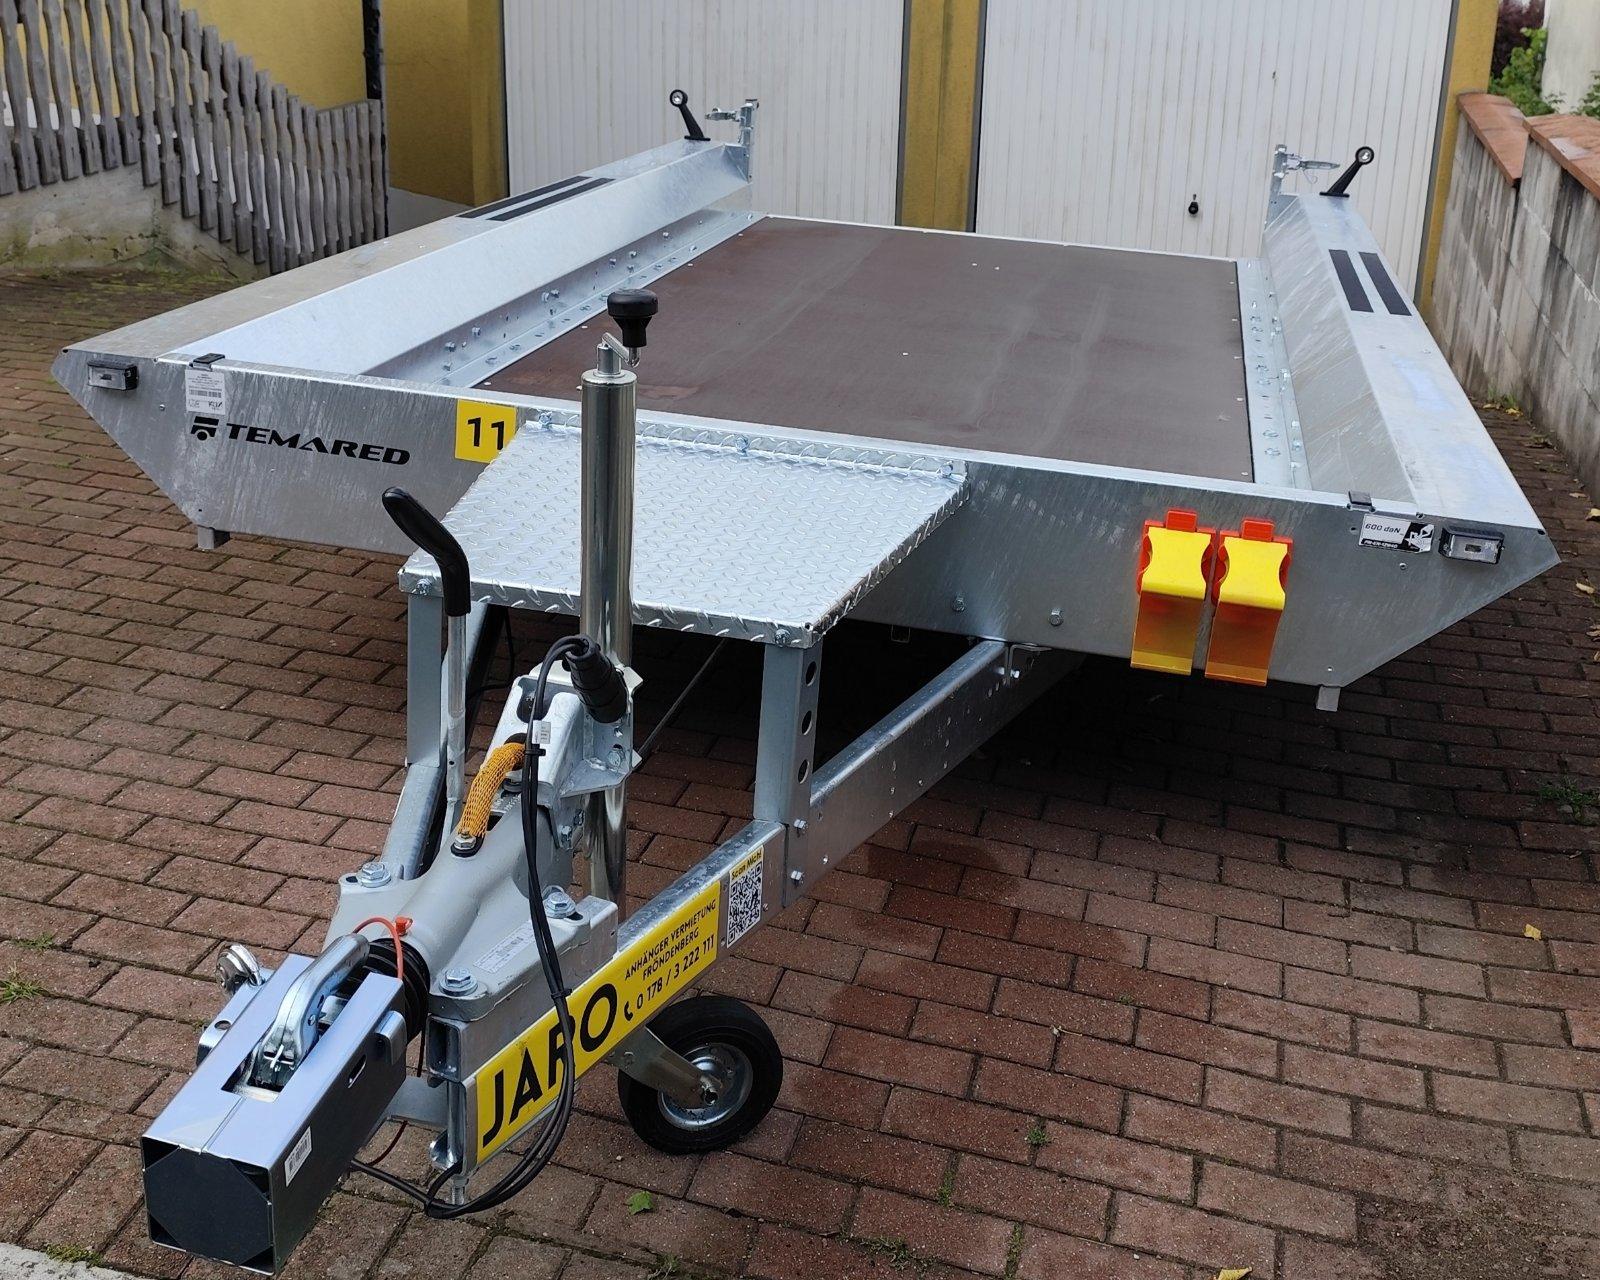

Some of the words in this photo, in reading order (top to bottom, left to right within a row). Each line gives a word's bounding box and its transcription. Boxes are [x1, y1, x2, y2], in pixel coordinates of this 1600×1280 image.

[225, 422, 411, 466] TEMARED
[467, 417, 505, 451] 11
[1365, 523, 1383, 531] 600
[1384, 526, 1400, 534] daN
[624, 936, 669, 981] ANHÄNGER
[670, 899, 716, 942] VERMIETUNG
[642, 926, 699, 981] FRÖNDENBERG
[636, 993, 644, 1010] 0
[646, 976, 663, 1002] 178
[666, 968, 672, 987] /
[673, 962, 680, 980] 3
[682, 946, 700, 972] 222
[702, 934, 715, 955] 111
